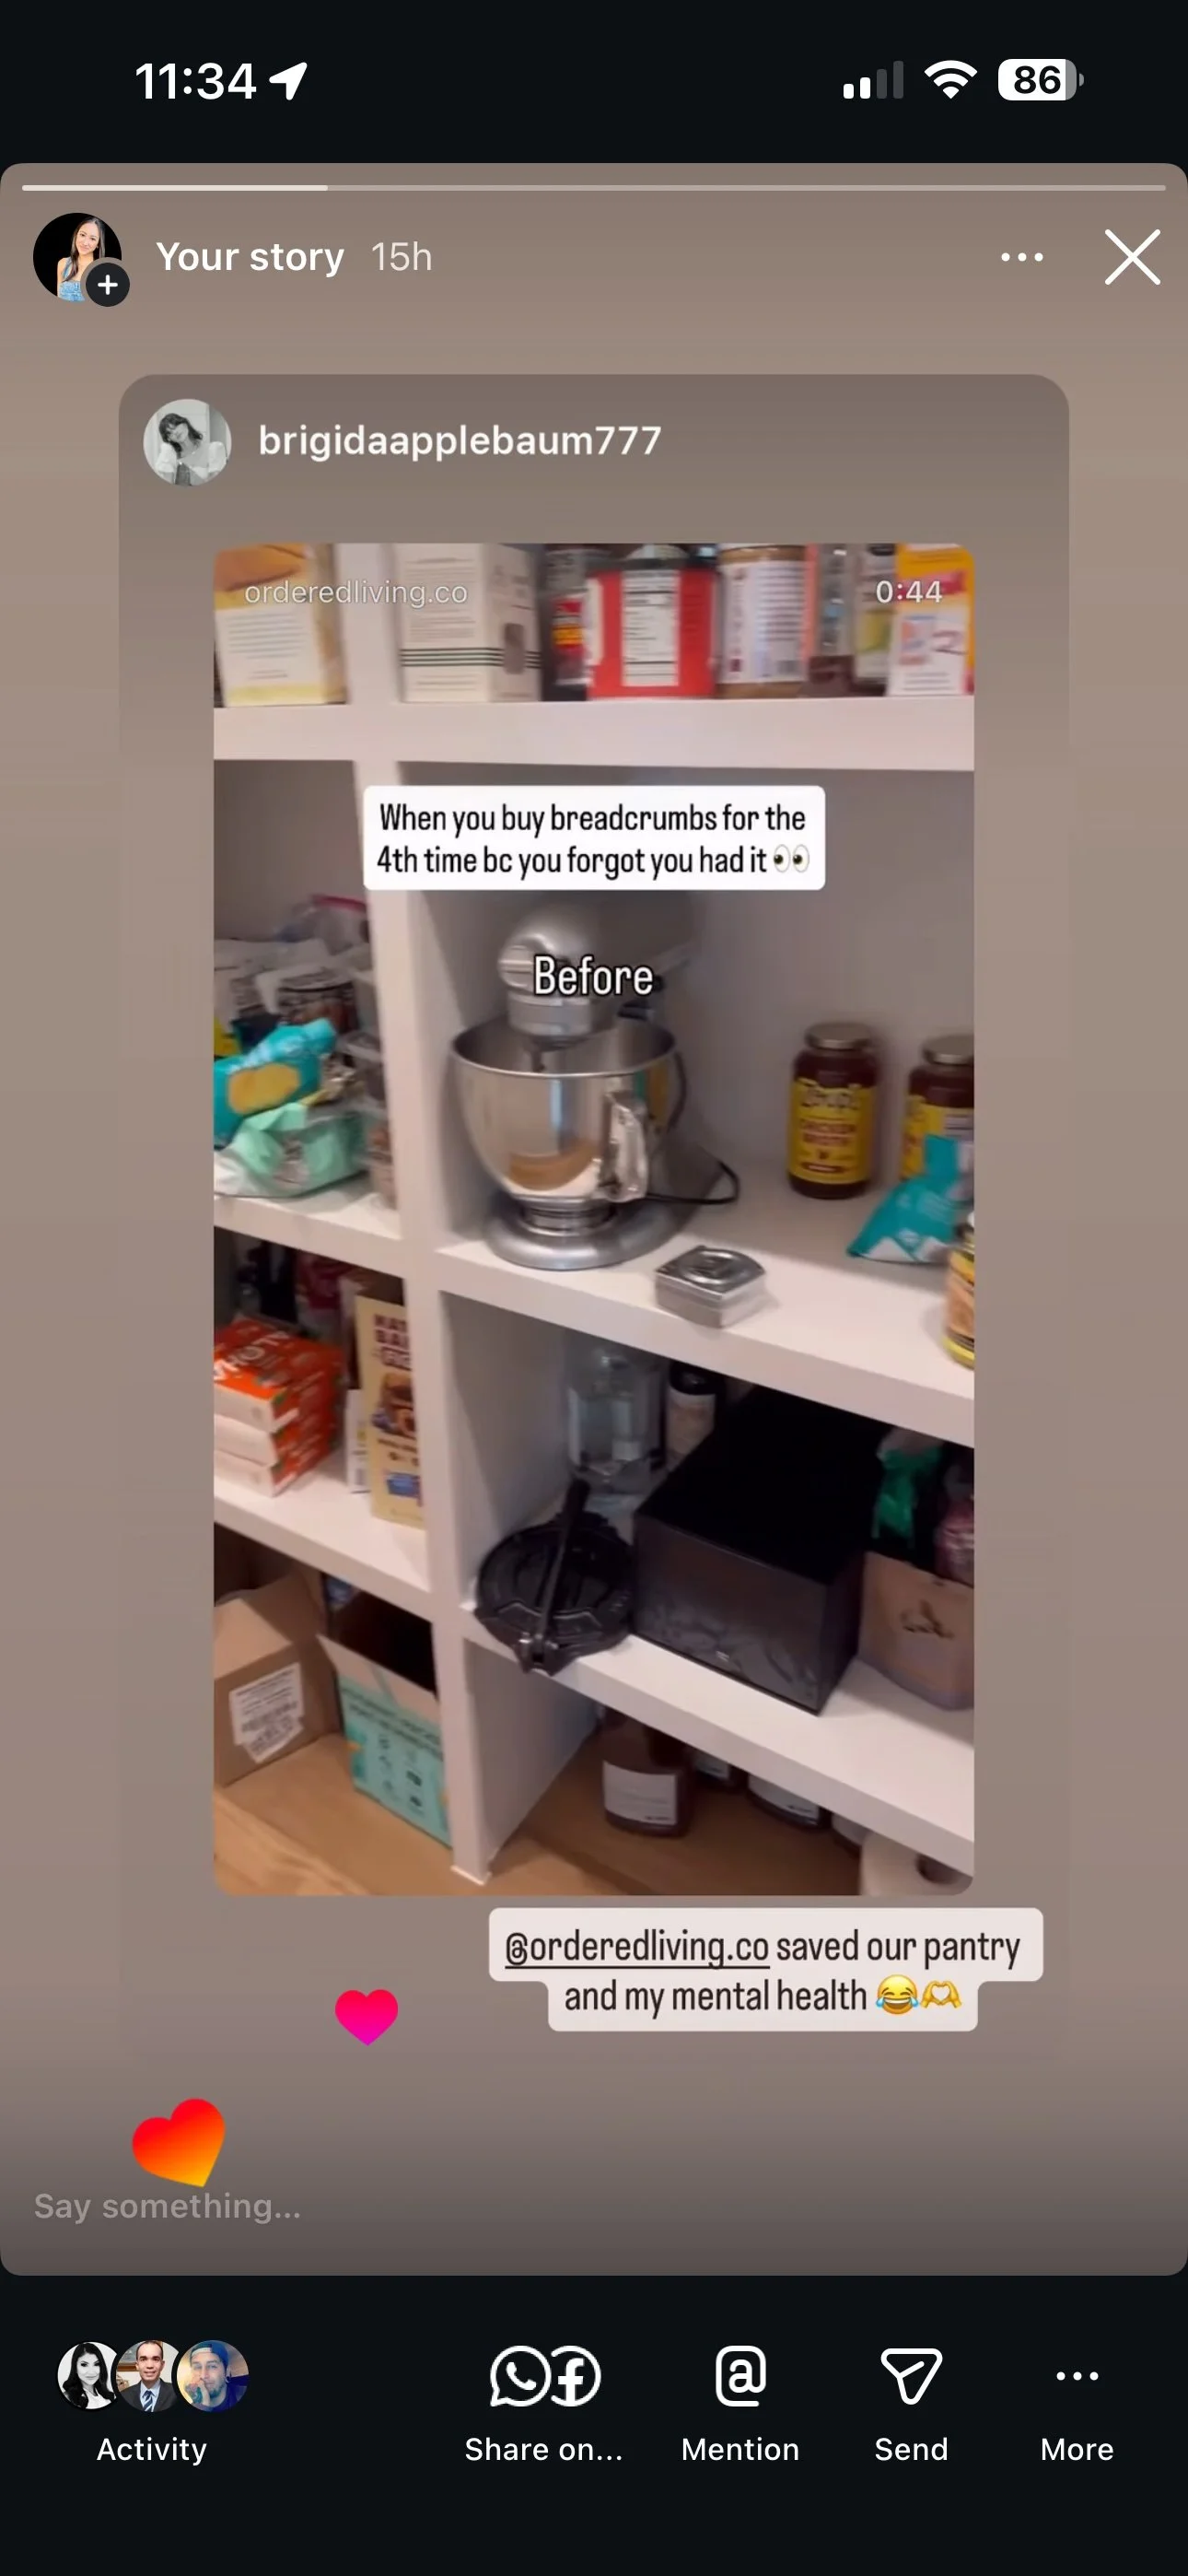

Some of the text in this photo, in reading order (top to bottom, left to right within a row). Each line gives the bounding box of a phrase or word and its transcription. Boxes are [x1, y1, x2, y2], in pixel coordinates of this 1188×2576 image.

[135, 62, 257, 100] 11:34
[1013, 64, 1062, 95] 86
[156, 241, 345, 278] Your story
[372, 240, 432, 272] 15h
[260, 424, 662, 463] brigidaapplebaum777
[34, 2192, 300, 2225] Say something...
[96, 2436, 207, 2466] Activity
[465, 2437, 623, 2462] Share on...
[682, 2437, 799, 2462] Mention
[875, 2437, 948, 2462] Send
[1042, 2437, 1114, 2462] More
